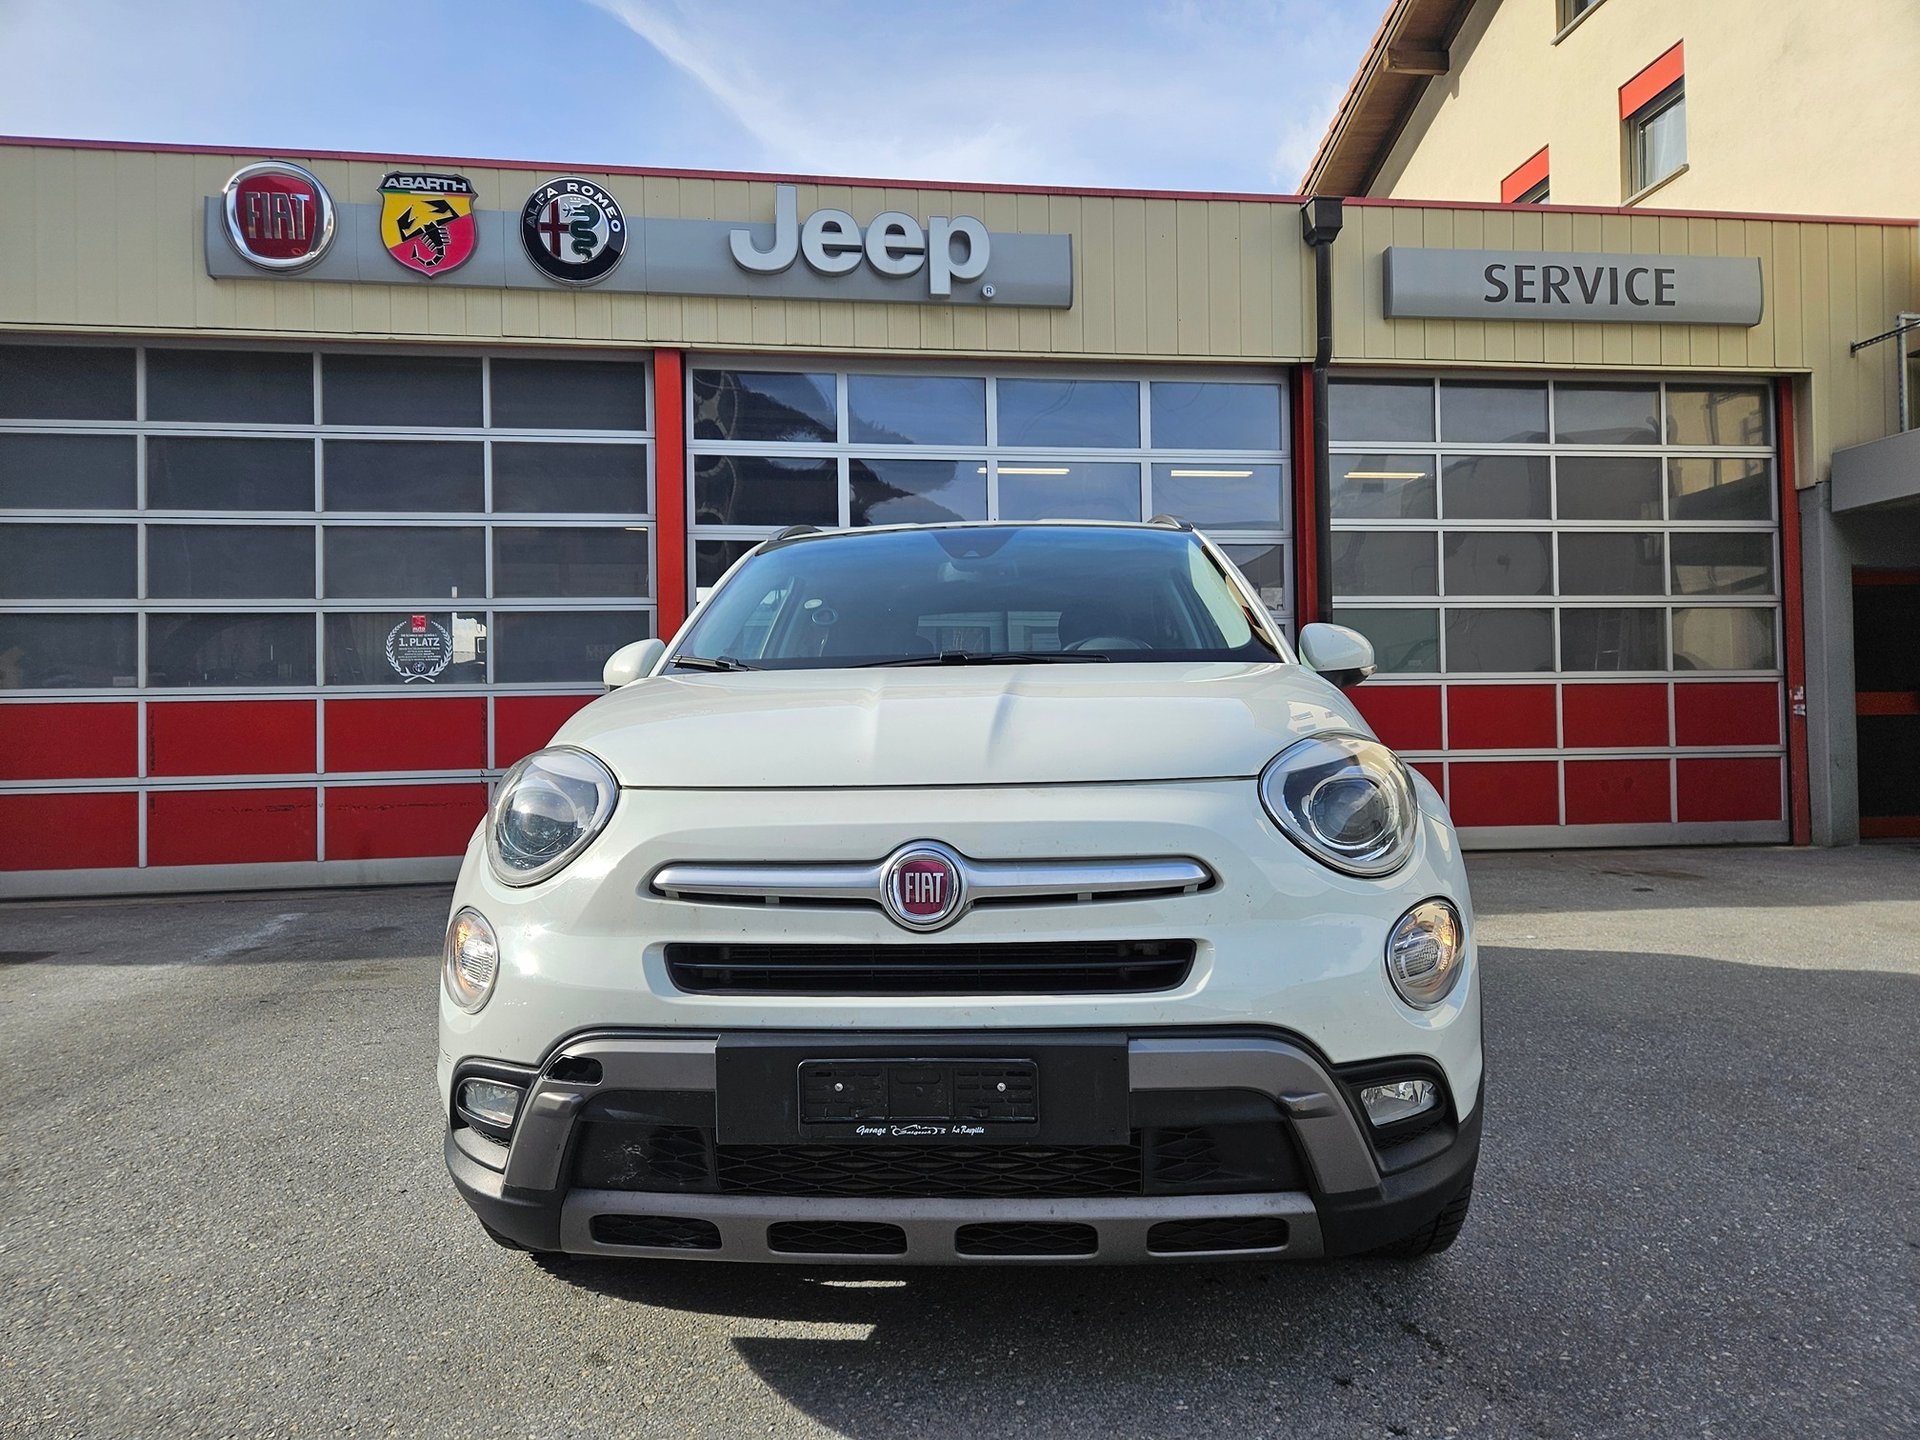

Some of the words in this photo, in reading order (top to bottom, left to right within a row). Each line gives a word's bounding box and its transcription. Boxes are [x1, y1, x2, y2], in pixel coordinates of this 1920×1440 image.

[384, 176, 468, 193] ABARTH
[245, 191, 310, 241] FIAT
[526, 187, 559, 229] ALFA
[566, 182, 621, 232] ROMEO
[729, 184, 992, 297] Jeep
[1483, 263, 1676, 307] SERVICE
[399, 638, 408, 647] 1.
[409, 638, 440, 647] PLATZ
[905, 872, 944, 903] FIAT
[856, 1125, 887, 1136] Garage
